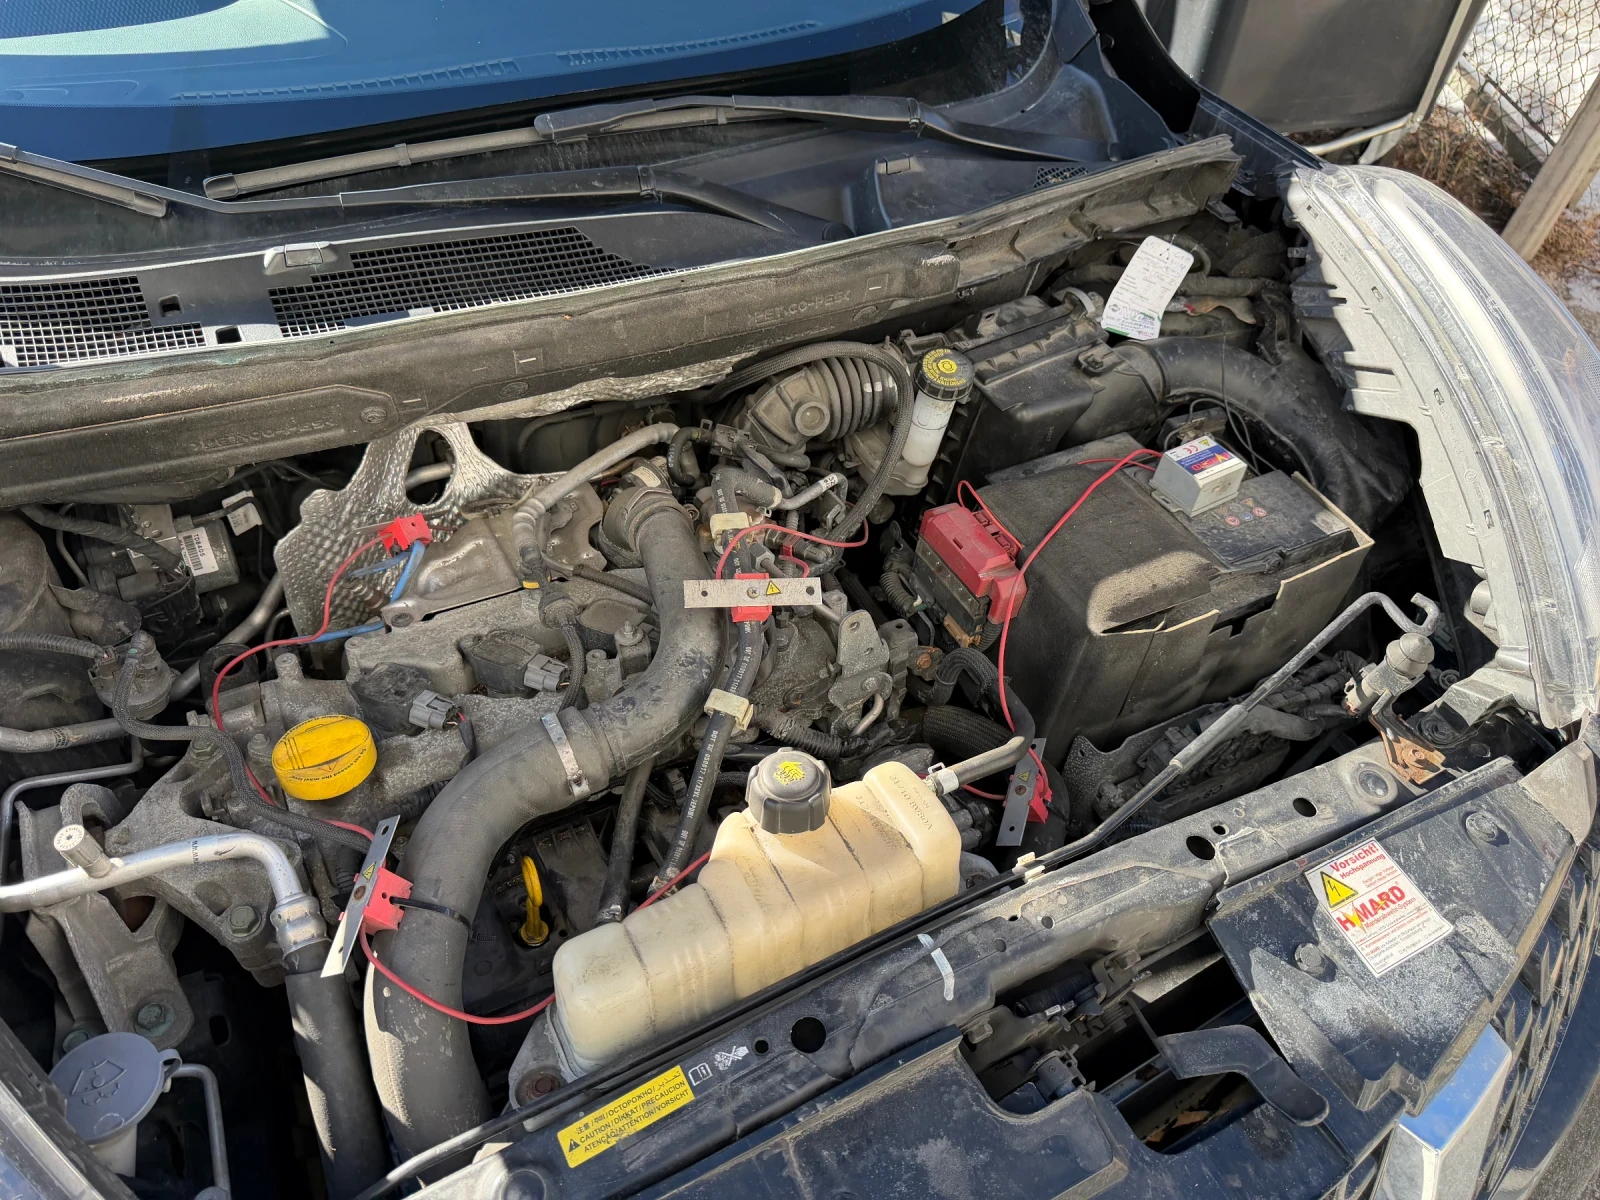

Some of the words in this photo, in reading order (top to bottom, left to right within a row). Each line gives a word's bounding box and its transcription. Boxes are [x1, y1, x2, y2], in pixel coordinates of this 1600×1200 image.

[1328, 841, 1379, 873] Vorsicht!
[1338, 852, 1386, 880] Hochspannung
[1363, 896, 1417, 929] Marderabwehr-System
